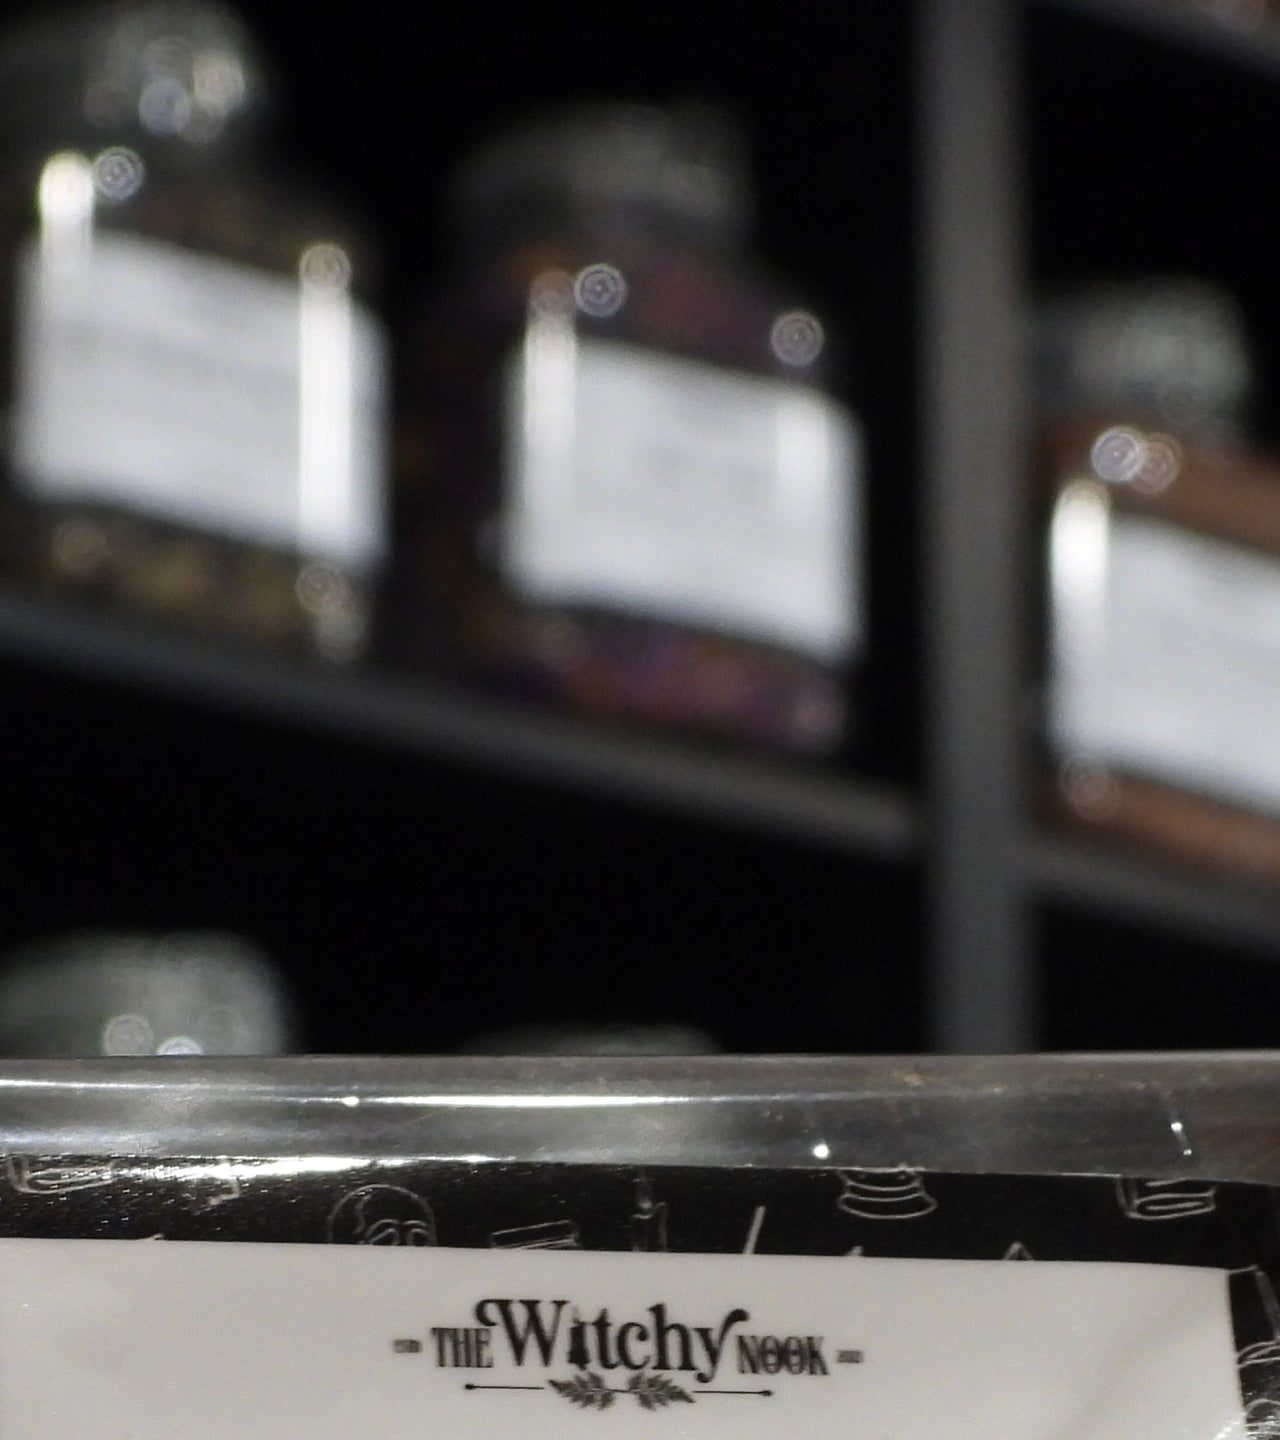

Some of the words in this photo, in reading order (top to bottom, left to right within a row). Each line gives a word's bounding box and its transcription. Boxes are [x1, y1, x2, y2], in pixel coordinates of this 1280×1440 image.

[430, 1327, 494, 1369] THE
[475, 1299, 750, 1382] Witchy
[737, 1335, 829, 1376] NOOK
